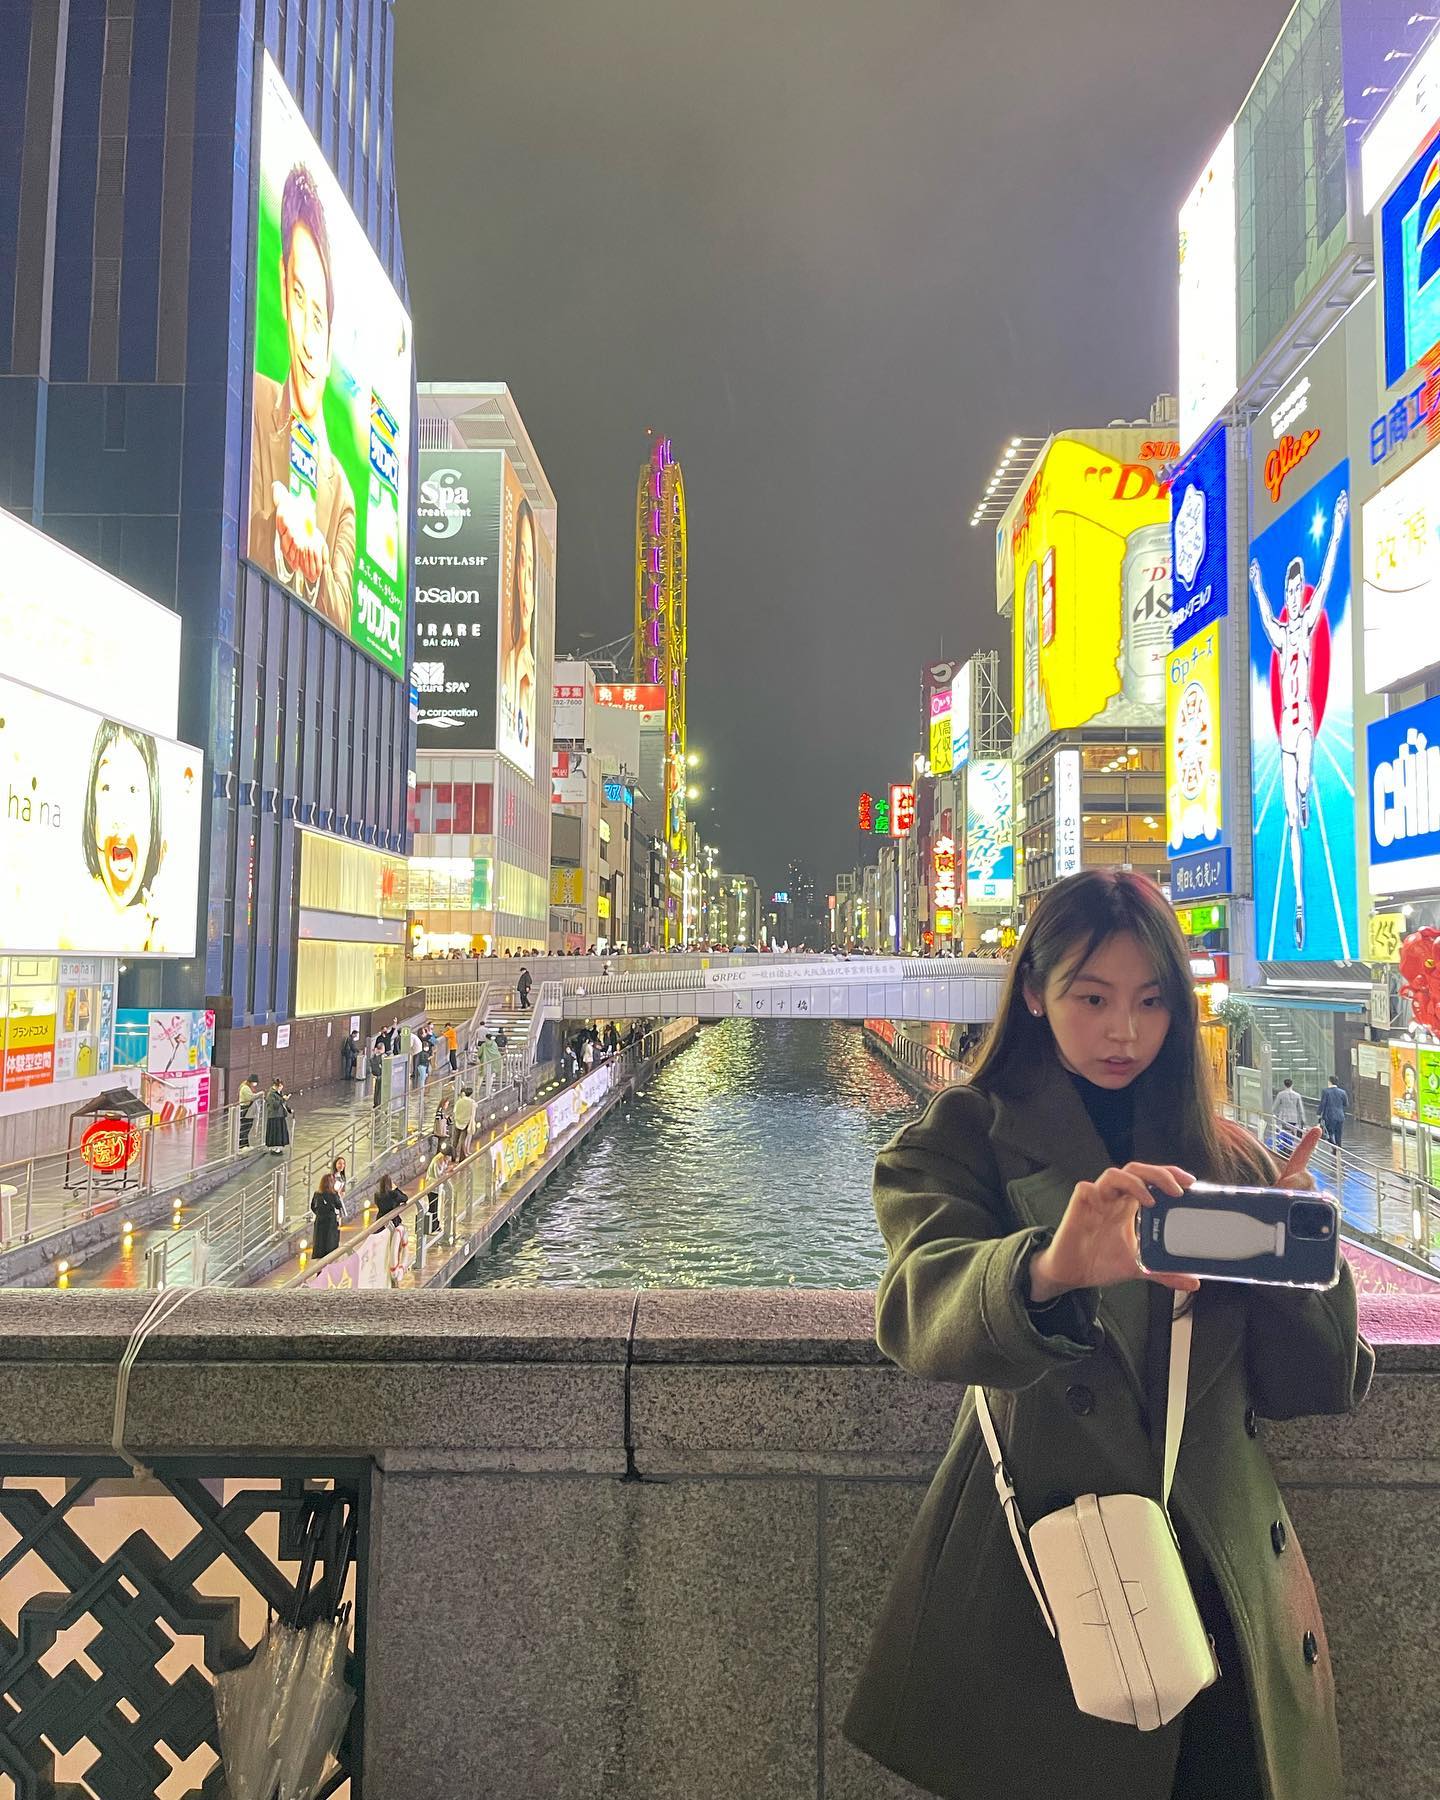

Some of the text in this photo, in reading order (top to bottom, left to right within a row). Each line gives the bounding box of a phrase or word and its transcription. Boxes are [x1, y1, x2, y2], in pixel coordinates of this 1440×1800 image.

[1264, 429, 1320, 503] Glico
[420, 480, 469, 509] Spa
[427, 707, 478, 719] corporation
[942, 719, 951, 769] 高収入
